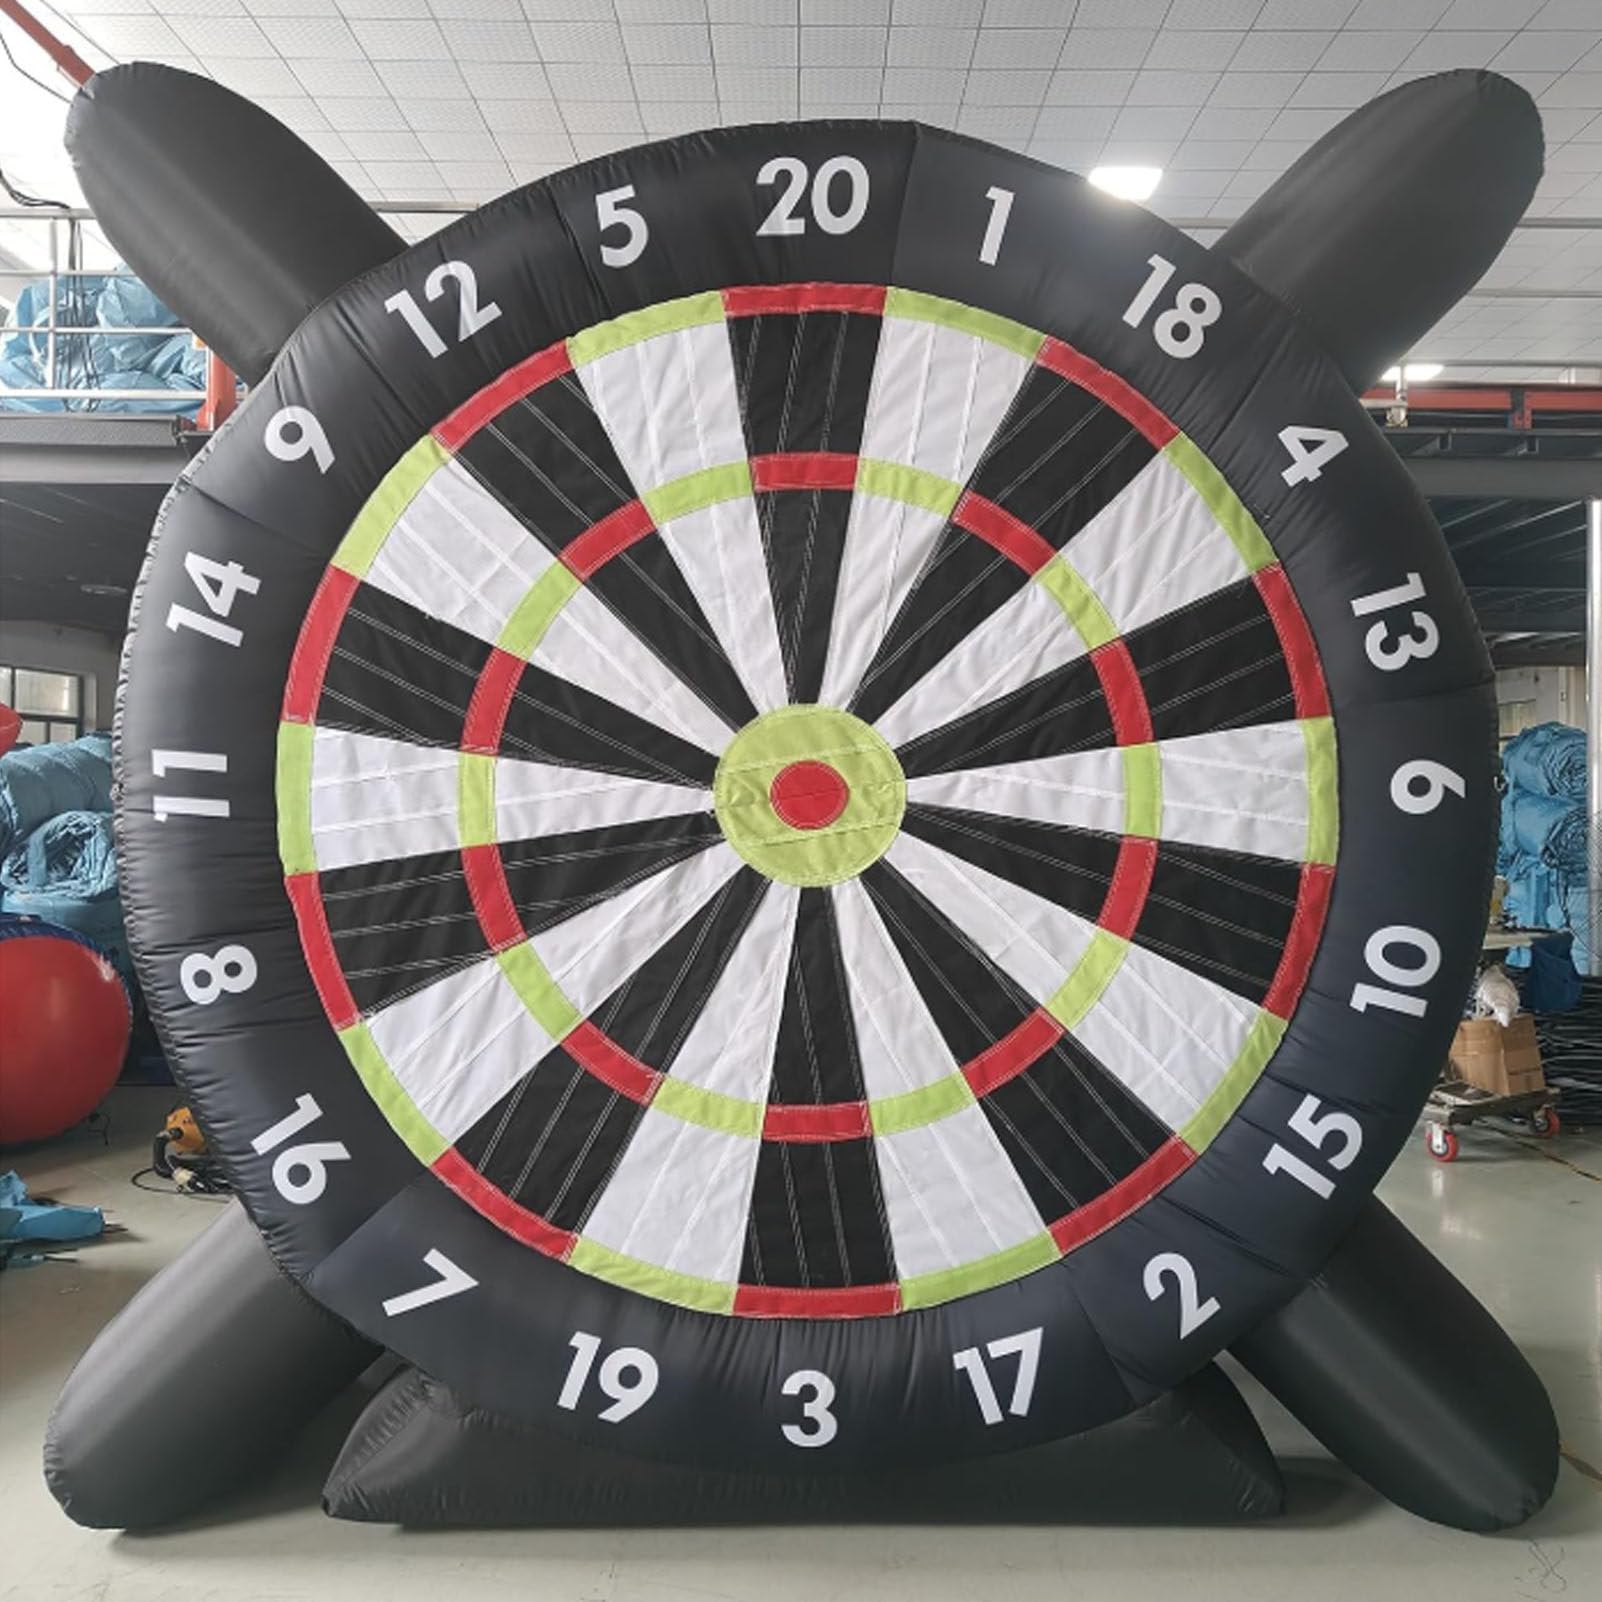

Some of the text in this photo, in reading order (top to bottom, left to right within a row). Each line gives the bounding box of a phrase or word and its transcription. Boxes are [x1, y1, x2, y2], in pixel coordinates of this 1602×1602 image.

[596, 185, 647, 266] 5
[757, 156, 869, 235] 20
[980, 187, 1014, 265] 1
[384, 261, 501, 357] 12
[1123, 254, 1221, 358] 18
[264, 405, 334, 473] 9
[1278, 426, 1348, 486] 4
[165, 552, 260, 648] 14
[1351, 572, 1437, 669] 13
[152, 749, 229, 822] 11
[1391, 761, 1464, 813] 6
[180, 945, 256, 1004] 8
[1350, 926, 1440, 1016] 10
[251, 1094, 350, 1204] 16
[1263, 1095, 1361, 1198] 15
[383, 1249, 478, 1316] 7
[1144, 1253, 1220, 1338] 2
[558, 1332, 658, 1422] 19
[782, 1370, 836, 1446] 3
[953, 1327, 1042, 1424] 17
